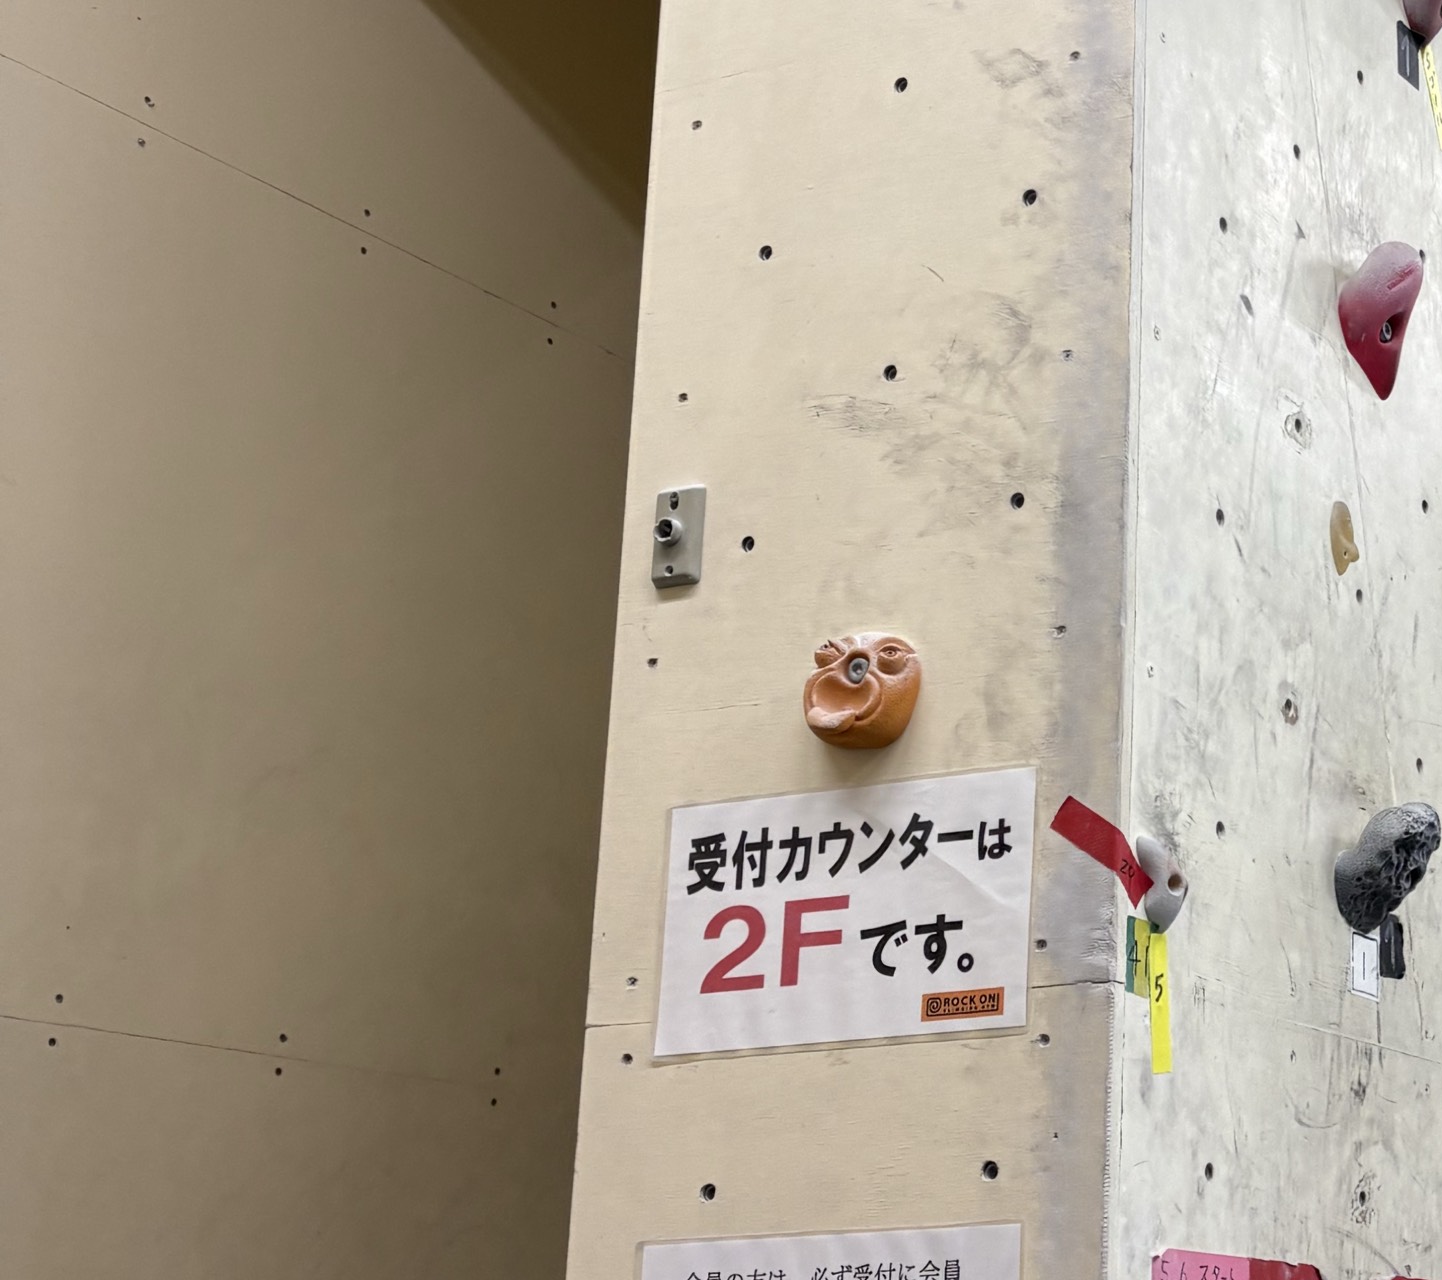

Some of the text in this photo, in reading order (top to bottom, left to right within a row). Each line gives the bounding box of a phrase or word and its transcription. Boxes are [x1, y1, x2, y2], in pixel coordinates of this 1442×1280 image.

[686, 811, 1013, 896] 受付カウンターは
[699, 894, 975, 995] 2Fです。
[943, 992, 996, 1008] ROCK ON
[1154, 972, 1165, 1003] 5
